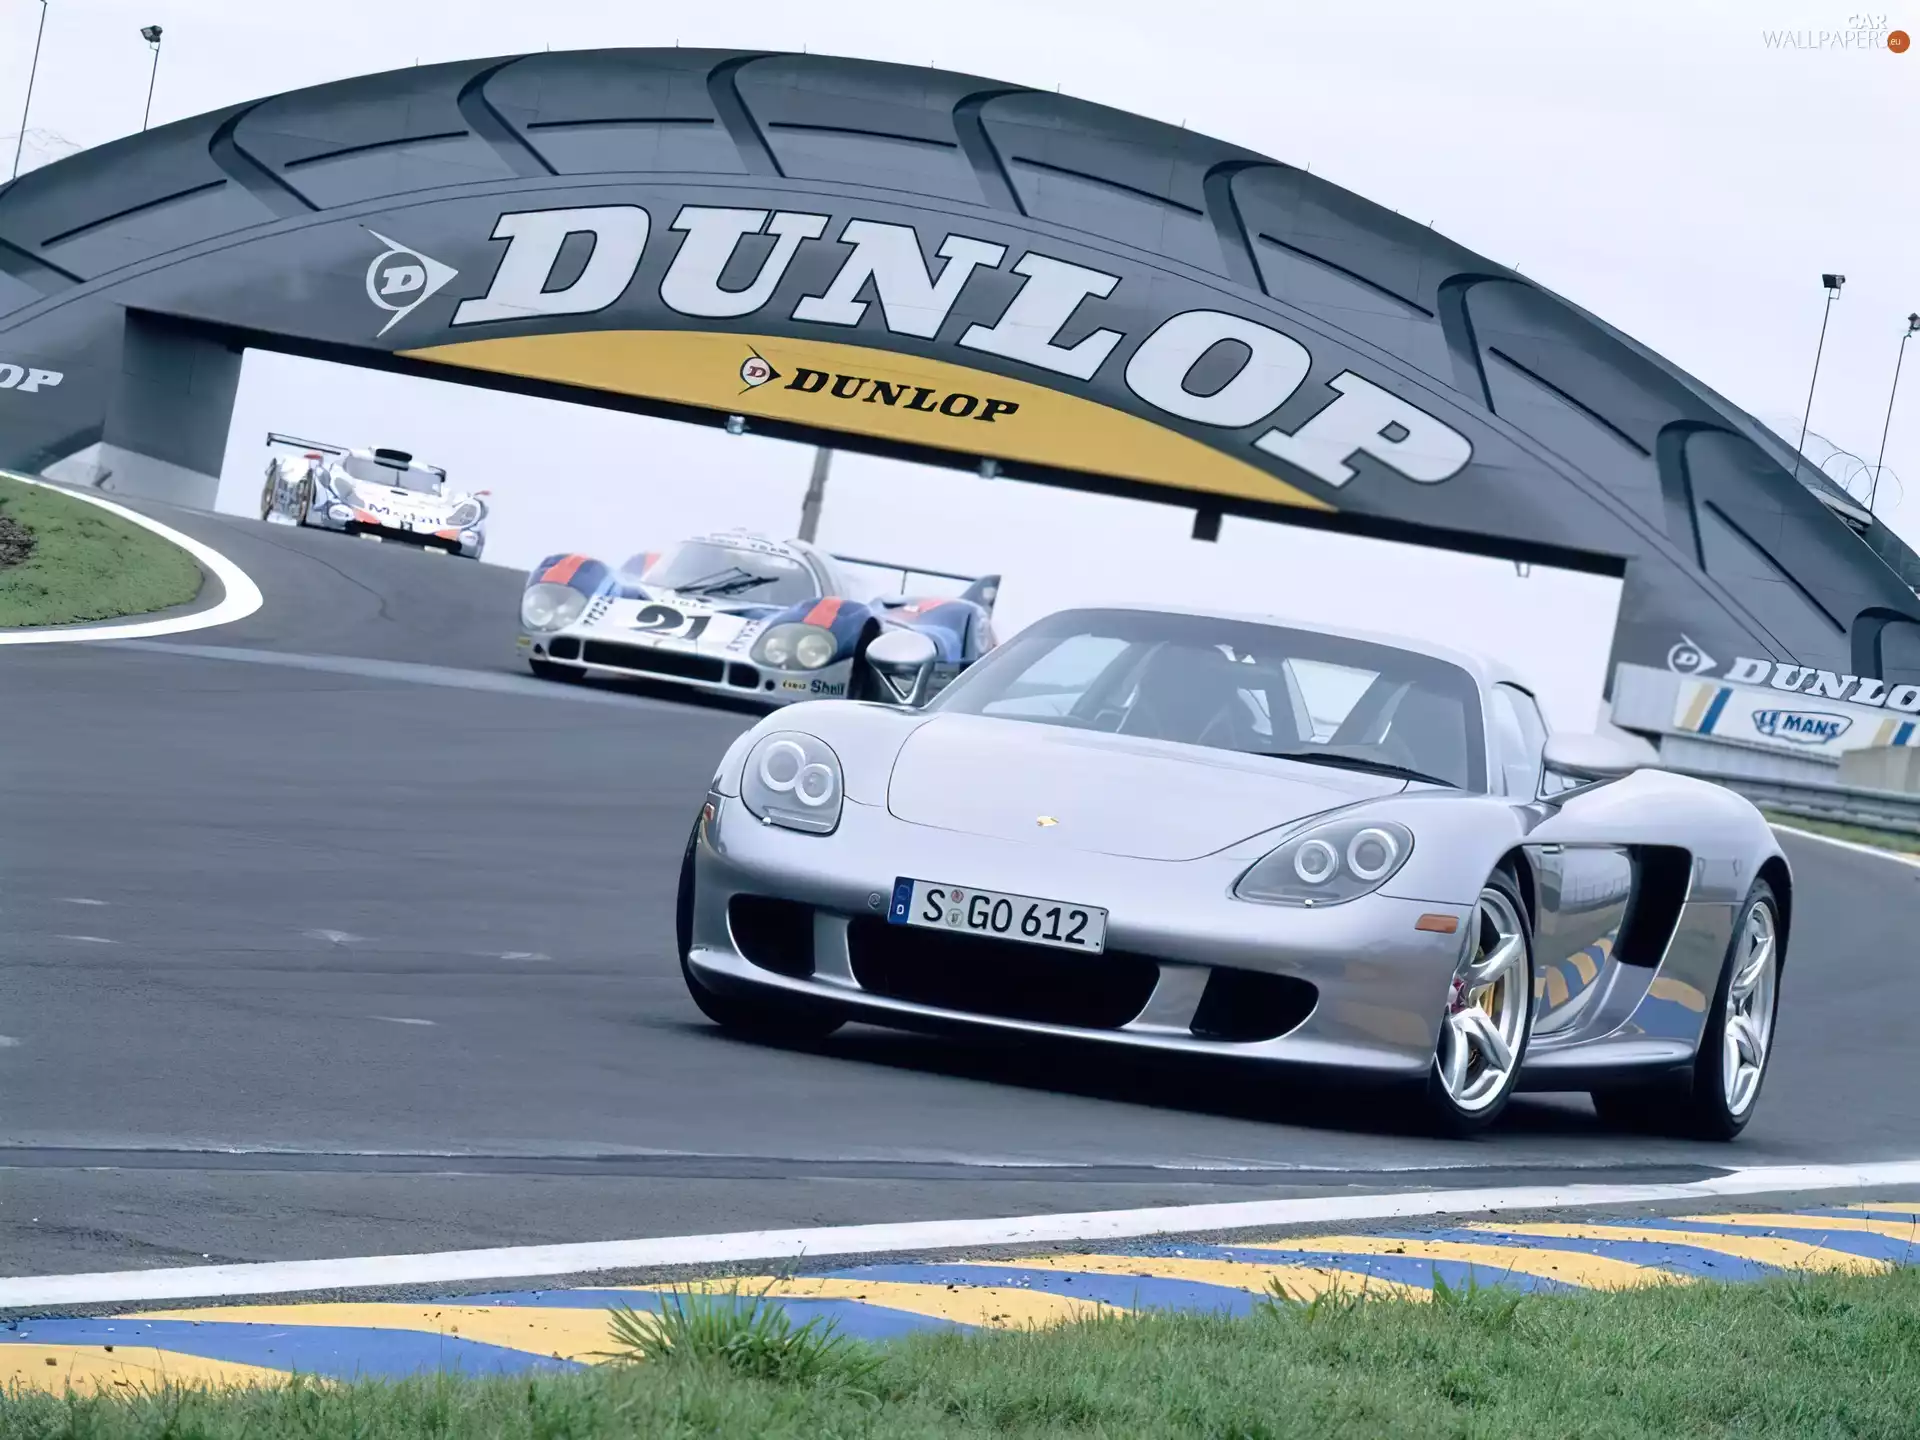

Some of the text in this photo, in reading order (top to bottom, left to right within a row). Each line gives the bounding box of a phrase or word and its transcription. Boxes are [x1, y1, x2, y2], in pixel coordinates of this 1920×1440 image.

[449, 203, 1474, 490] DUNLOP
[784, 367, 1020, 422] DUNLOP
[629, 605, 712, 639] 21
[811, 679, 845, 696] Shell
[1782, 714, 1840, 737] MANS
[922, 889, 946, 922] S
[967, 895, 1013, 933] GO
[1020, 904, 1089, 945] 612
